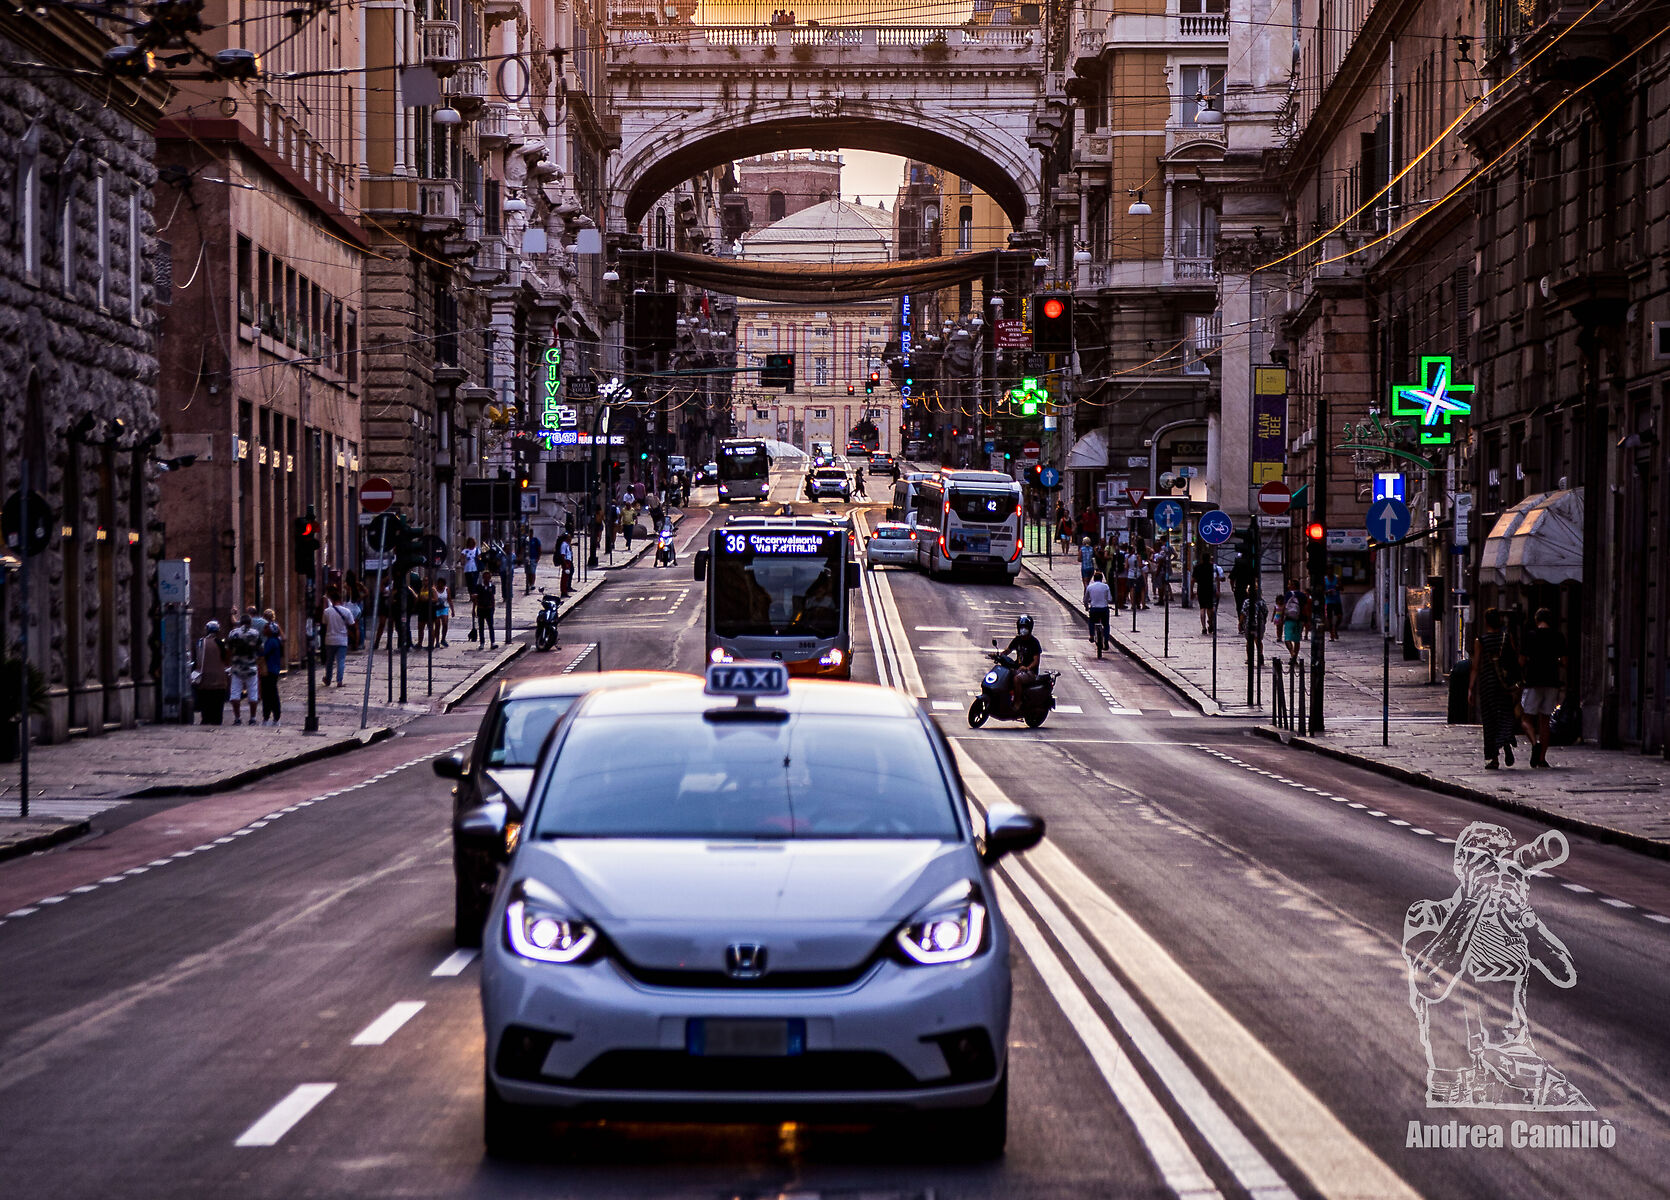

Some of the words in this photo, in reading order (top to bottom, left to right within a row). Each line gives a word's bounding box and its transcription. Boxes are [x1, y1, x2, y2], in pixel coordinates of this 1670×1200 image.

[1258, 413, 1270, 439] ALAN
[1270, 416, 1281, 436] BEE
[988, 501, 997, 511] 42
[726, 535, 746, 552] 36
[756, 544, 771, 552] Via
[715, 671, 779, 688] TAXI
